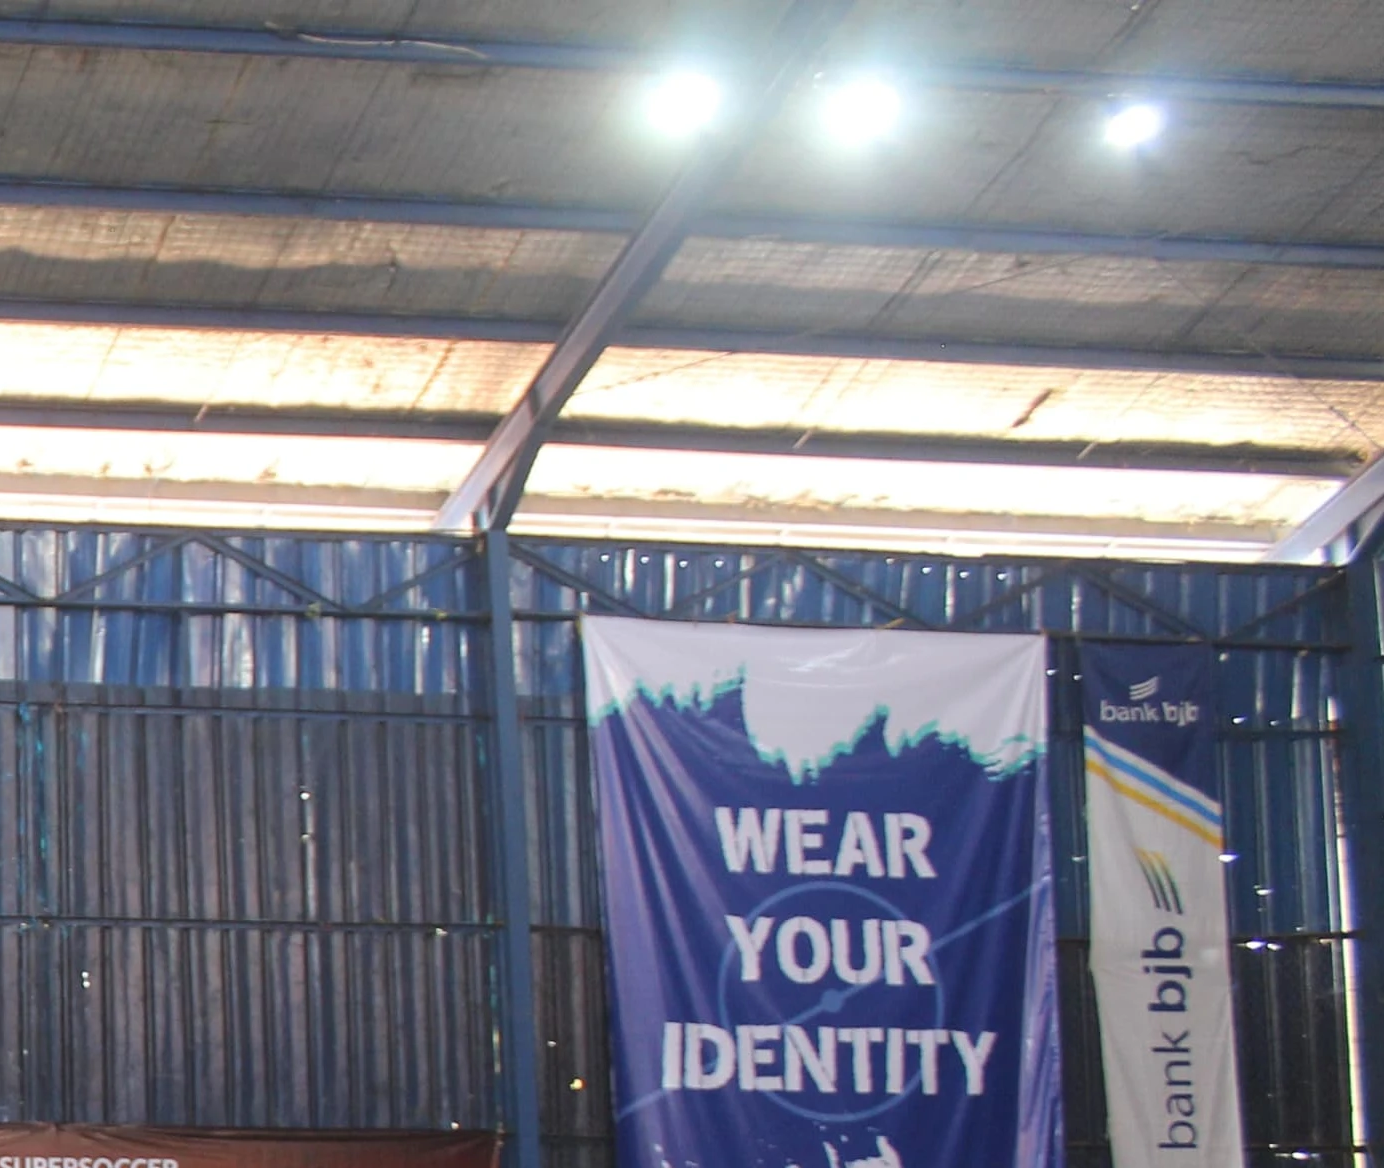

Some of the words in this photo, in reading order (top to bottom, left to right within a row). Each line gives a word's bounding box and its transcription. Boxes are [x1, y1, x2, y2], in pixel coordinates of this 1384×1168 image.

[1099, 700, 1159, 721] bank
[714, 807, 938, 879] WEAR
[725, 915, 937, 986] YOUR
[1140, 926, 1193, 1012] bjb
[662, 1022, 997, 1096] IDENTITY
[1151, 1029, 1198, 1149] bank
